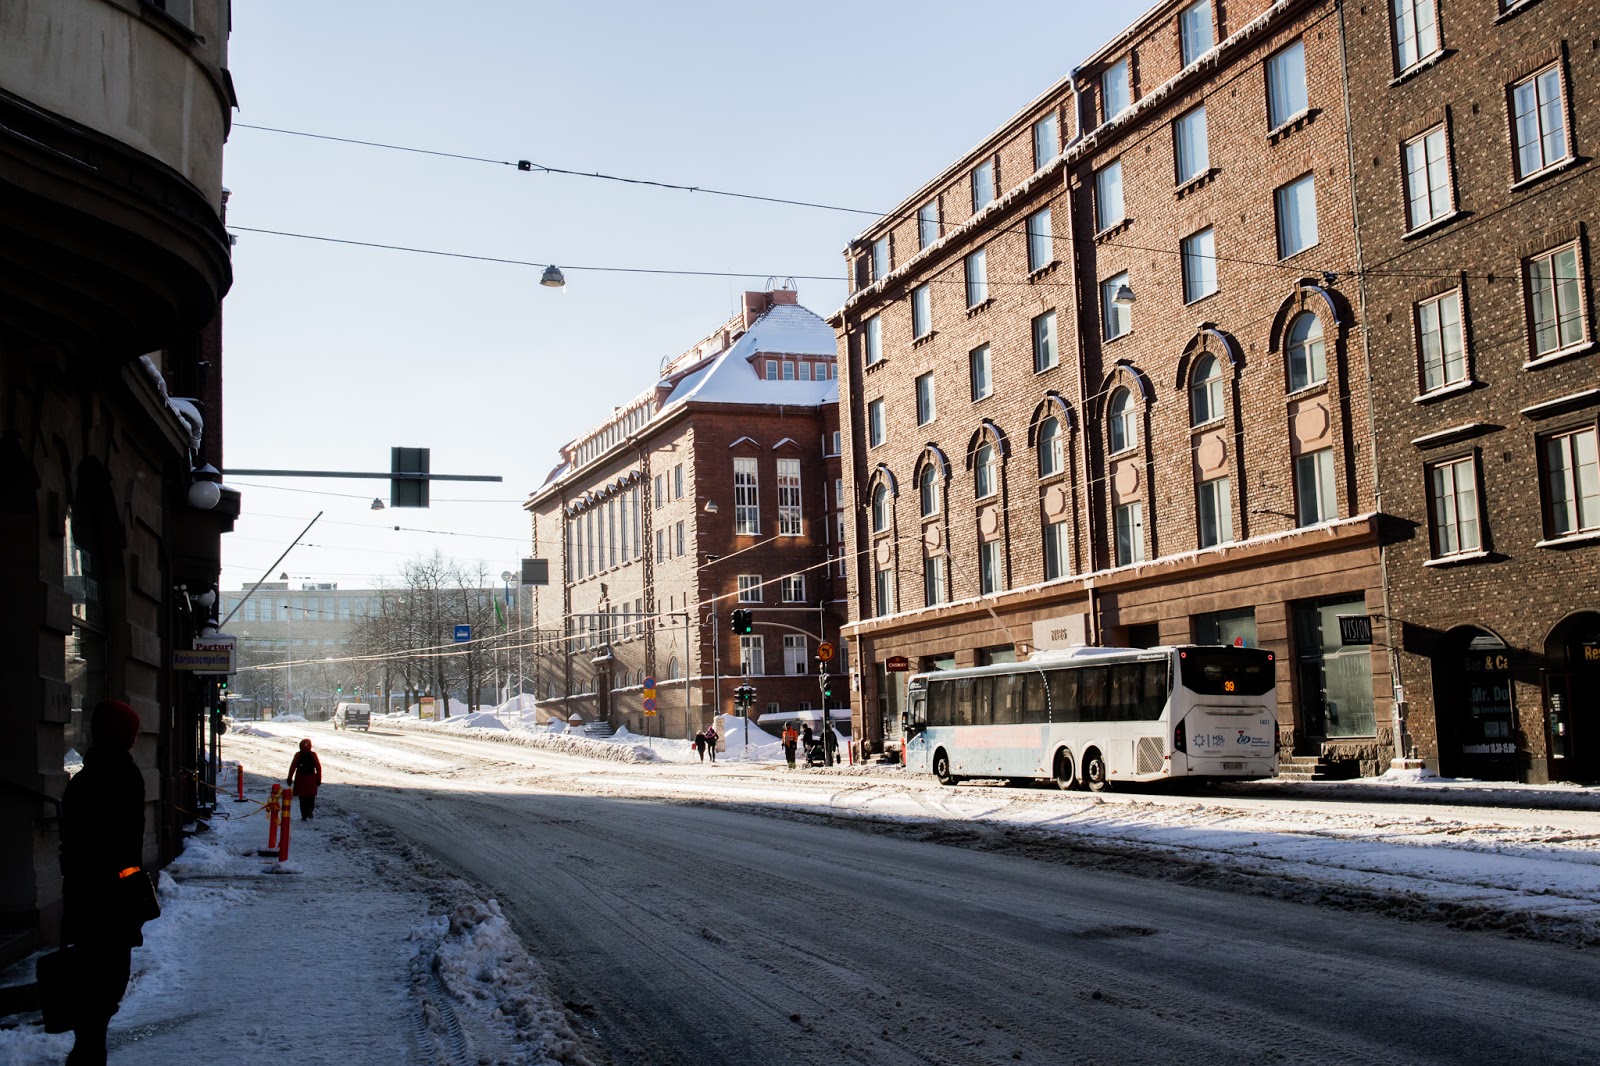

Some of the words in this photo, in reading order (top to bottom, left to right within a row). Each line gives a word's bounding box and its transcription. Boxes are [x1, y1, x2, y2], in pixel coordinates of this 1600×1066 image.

[1342, 620, 1370, 638] VISION
[196, 643, 233, 651] Parturi
[1464, 657, 1482, 672] Bar
[1485, 655, 1494, 671] &
[1224, 681, 1235, 691] 39
[1471, 687, 1491, 702] Mr.
